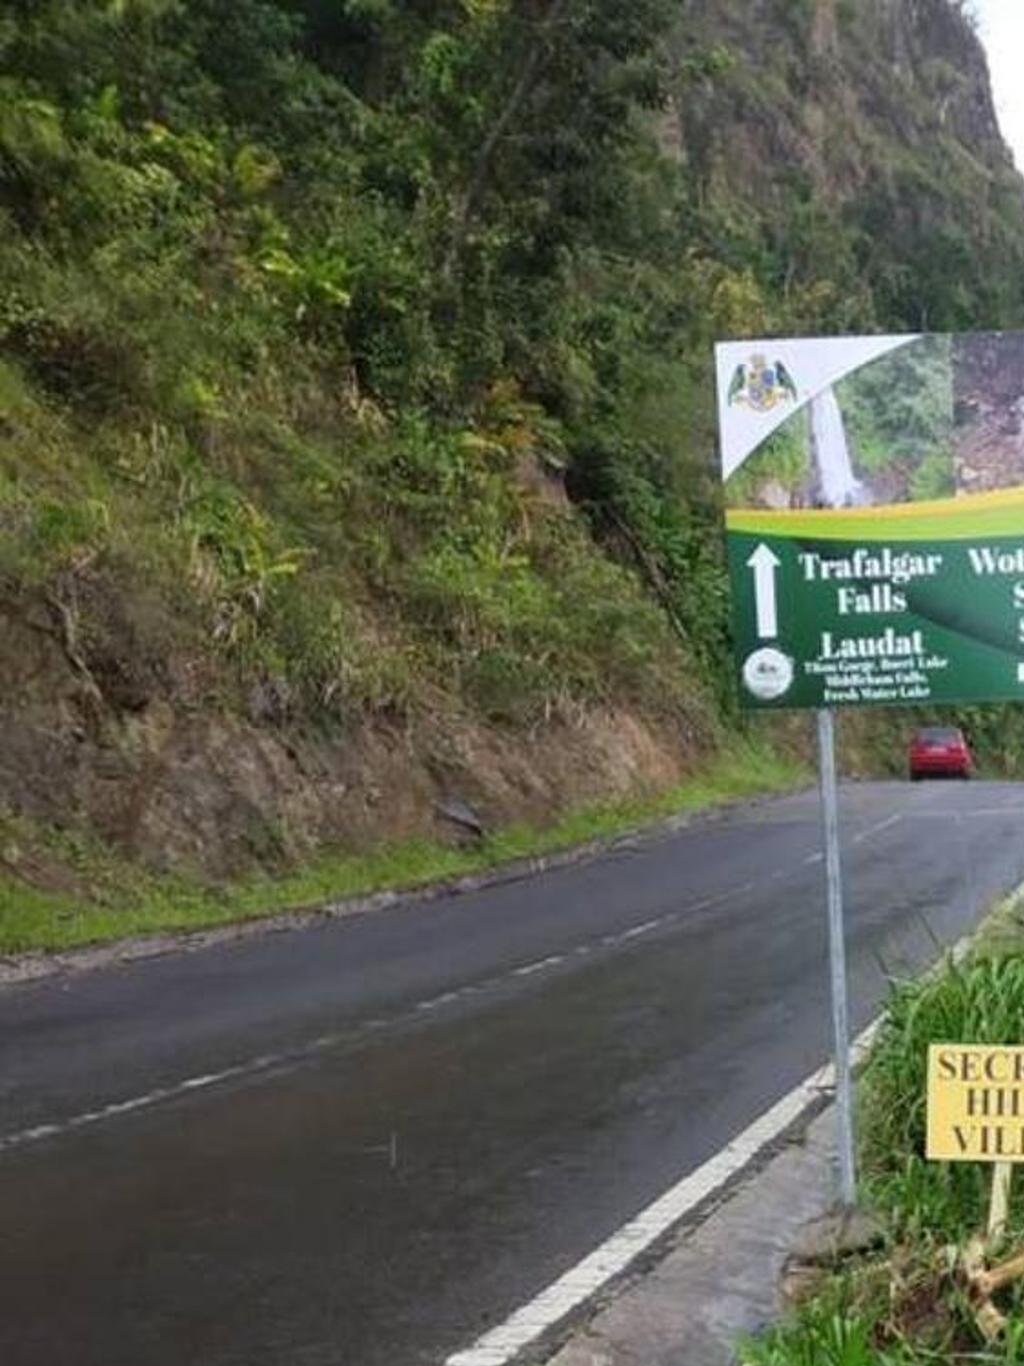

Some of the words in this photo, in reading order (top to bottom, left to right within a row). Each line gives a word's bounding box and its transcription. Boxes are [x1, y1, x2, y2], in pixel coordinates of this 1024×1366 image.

[798, 548, 942, 584] Trafalgar
[838, 583, 908, 615] Falls
[818, 627, 925, 660] Laudat
[900, 685, 931, 698] Lake
